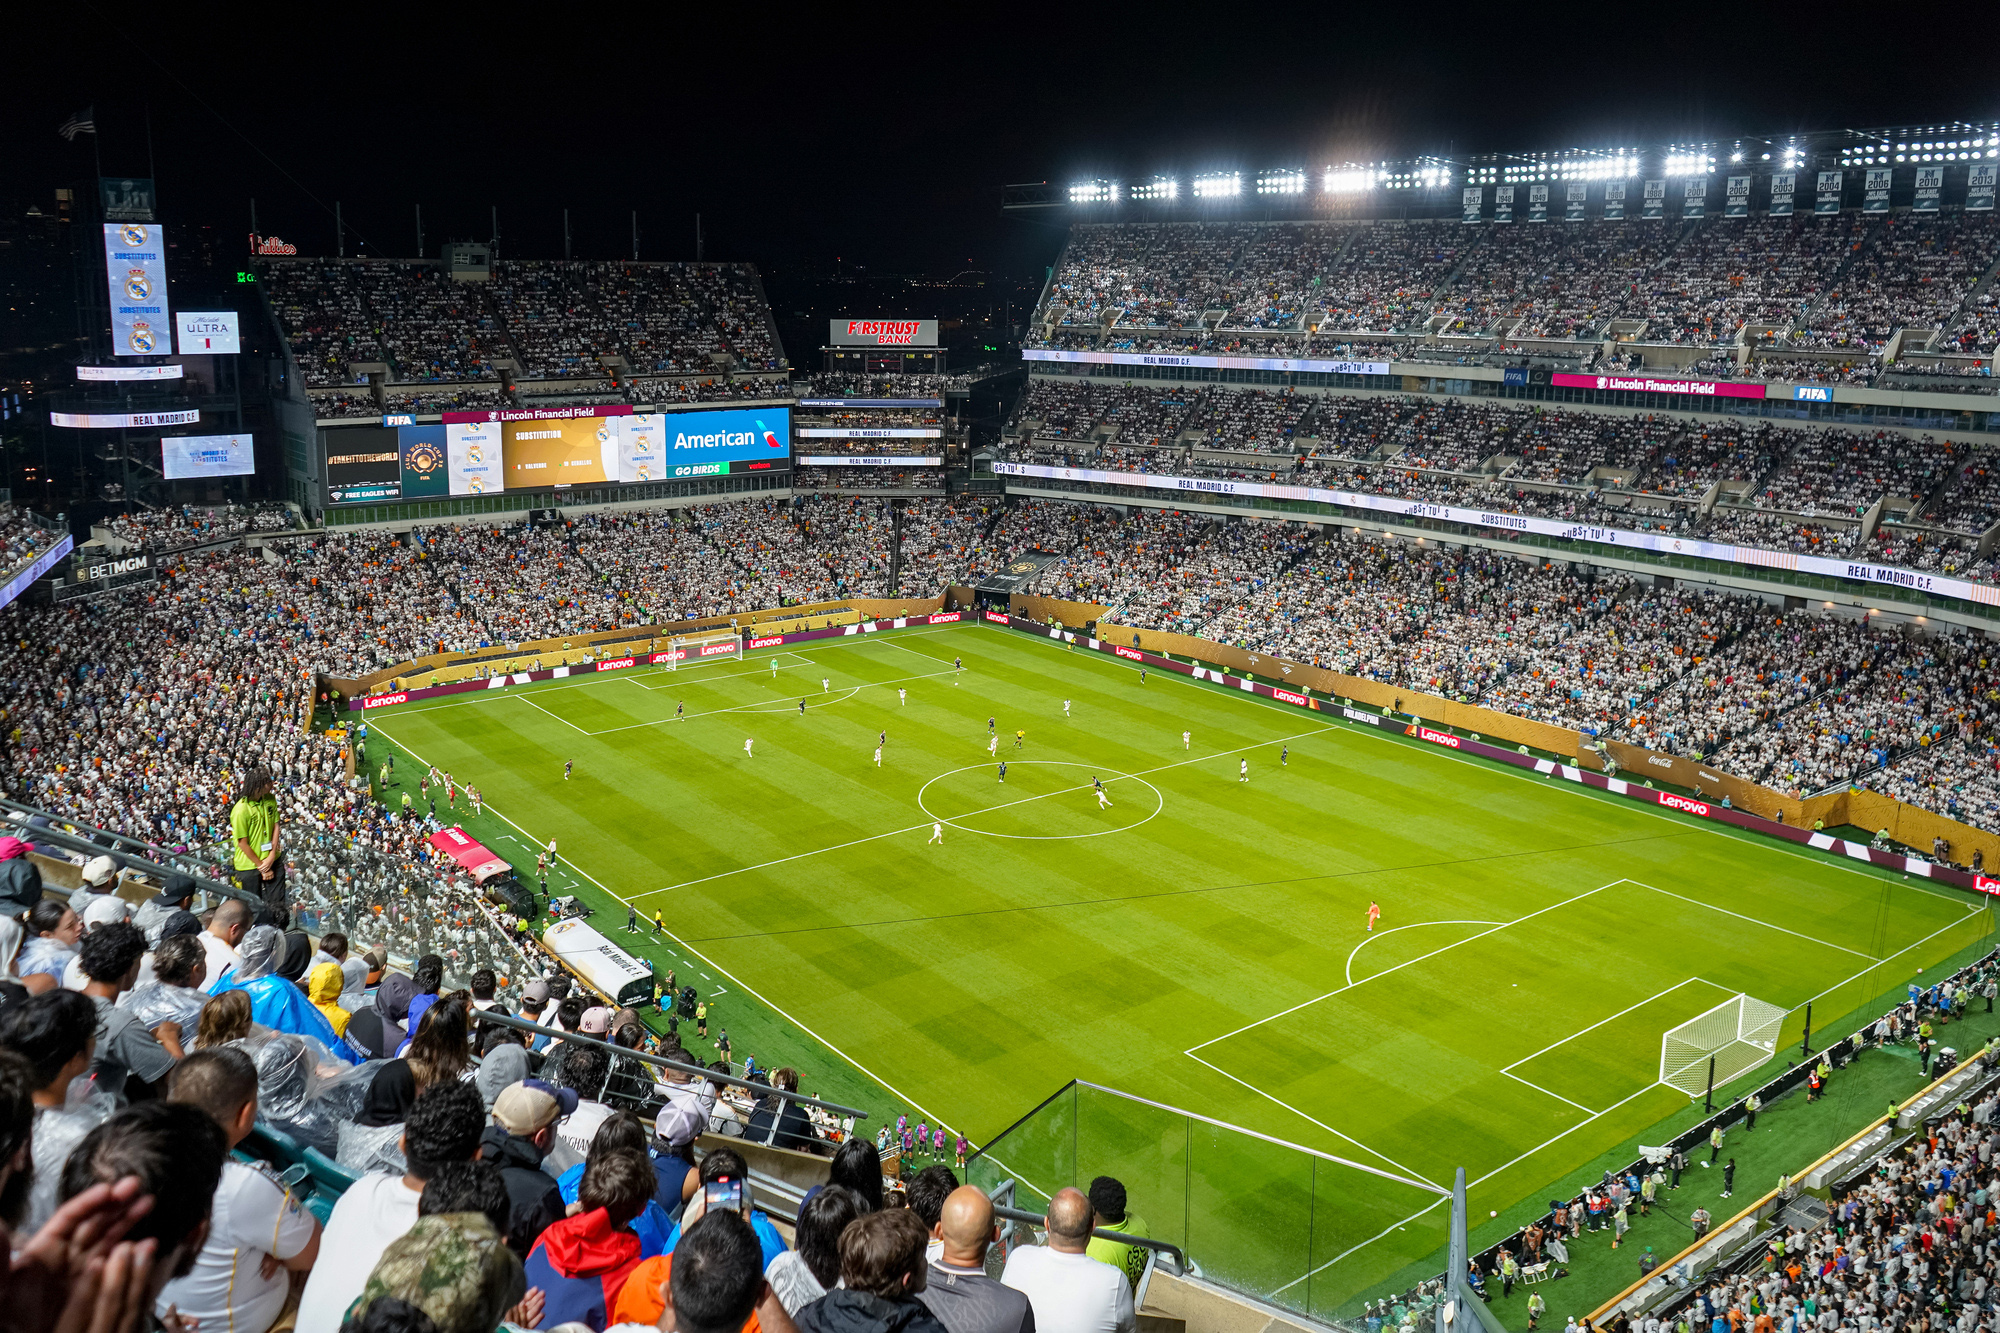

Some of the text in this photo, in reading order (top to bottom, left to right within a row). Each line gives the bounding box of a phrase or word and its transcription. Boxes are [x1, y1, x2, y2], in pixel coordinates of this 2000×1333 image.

[1867, 179, 1889, 189] 2006
[1918, 177, 1939, 187] 2010
[1971, 175, 1993, 185] 2013
[1729, 187, 1748, 195] 2002
[1773, 184, 1793, 193] 2003
[1819, 181, 1840, 191] 2004
[1608, 191, 1624, 199] 1980
[1687, 188, 1704, 196] 2001
[1498, 195, 1512, 203] 1948
[187, 323, 228, 333] ULTRA
[878, 335, 912, 344] BANK
[1143, 356, 1157, 365] REAL
[1159, 357, 1180, 366] MADRID
[1505, 372, 1523, 381] FIFA
[1609, 378, 1716, 395] Lincoln Financial Field
[1799, 387, 1827, 400] FIFA
[501, 407, 595, 420] Lincoln Financial Field
[133, 415, 155, 426] REAL
[157, 413, 185, 424] MADRID
[387, 415, 412, 426] FIFA
[516, 430, 561, 441] SUBSTITUTION
[674, 429, 755, 450] American
[692, 464, 720, 475] BIRDS
[1178, 480, 1236, 493] REAL MADRID C.F.
[1481, 513, 1527, 529] SUBSTITUTES
[89, 556, 147, 579] BETMGM
[1847, 565, 1933, 590] REAL MADRID C.F.
[929, 614, 959, 623] Lenovo
[986, 613, 1007, 623] Lenovo
[750, 636, 782, 648] Lenovo
[701, 647, 734, 656] Lenovo
[1116, 647, 1142, 660] Lenovo
[598, 659, 633, 670] Lenovo
[365, 694, 406, 708] Lenovo
[1274, 689, 1305, 705] Lenovo
[1344, 708, 1379, 725] PHILADELPHIA
[1421, 731, 1458, 747] Lenovo
[1699, 771, 1719, 783] Hisense
[1660, 792, 1707, 815] Lenovo
[608, 954, 632, 969] Madrid
